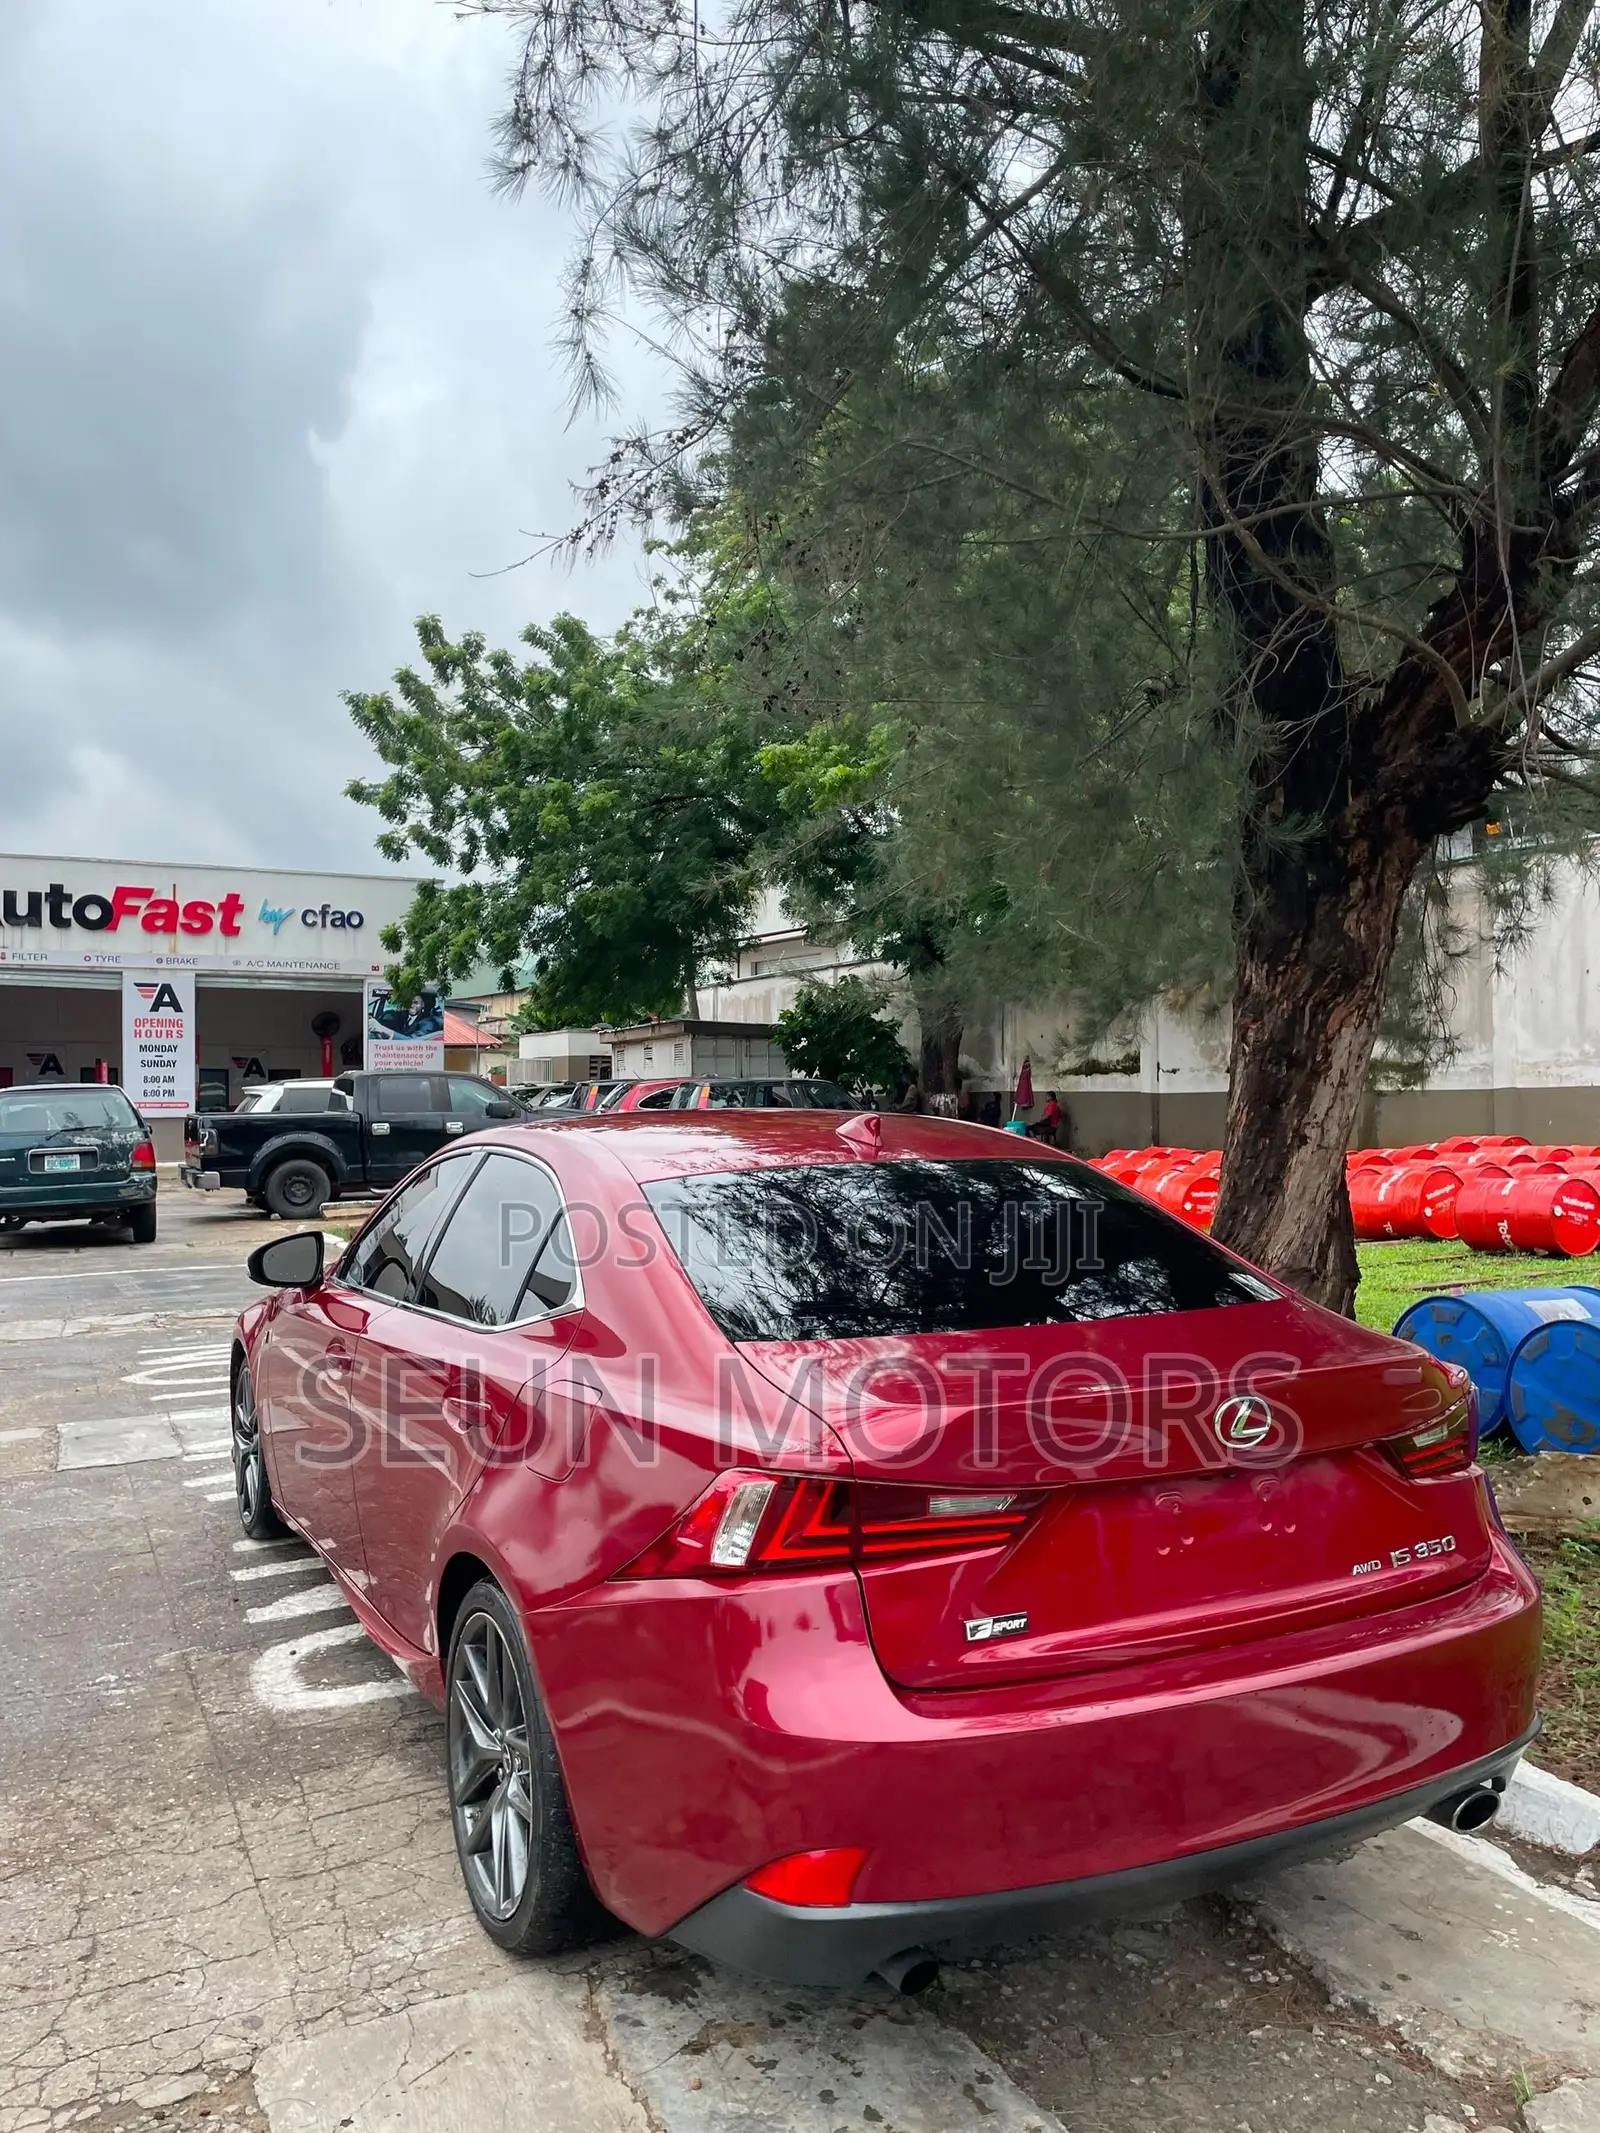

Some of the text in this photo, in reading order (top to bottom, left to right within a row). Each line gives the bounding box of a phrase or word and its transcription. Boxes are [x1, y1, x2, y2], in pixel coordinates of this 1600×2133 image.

[0, 883, 364, 936] utoFast by cfao
[12, 952, 48, 961] FILTER
[95, 955, 122, 963] TYRE
[166, 957, 199, 965] BRAKE
[246, 960, 341, 970] A/C MAINTENANCE
[134, 1018, 184, 1029] OPENING
[134, 1029, 184, 1039] HOURS
[139, 1044, 178, 1053] MONDAY
[140, 1059, 177, 1068] SUNDAY
[143, 1075, 175, 1084] 8:00 AM
[143, 1089, 175, 1098] 6:00 PM
[1352, 1535, 1457, 1576] AWD IS 350
[993, 1618, 1028, 1633] SPORT
